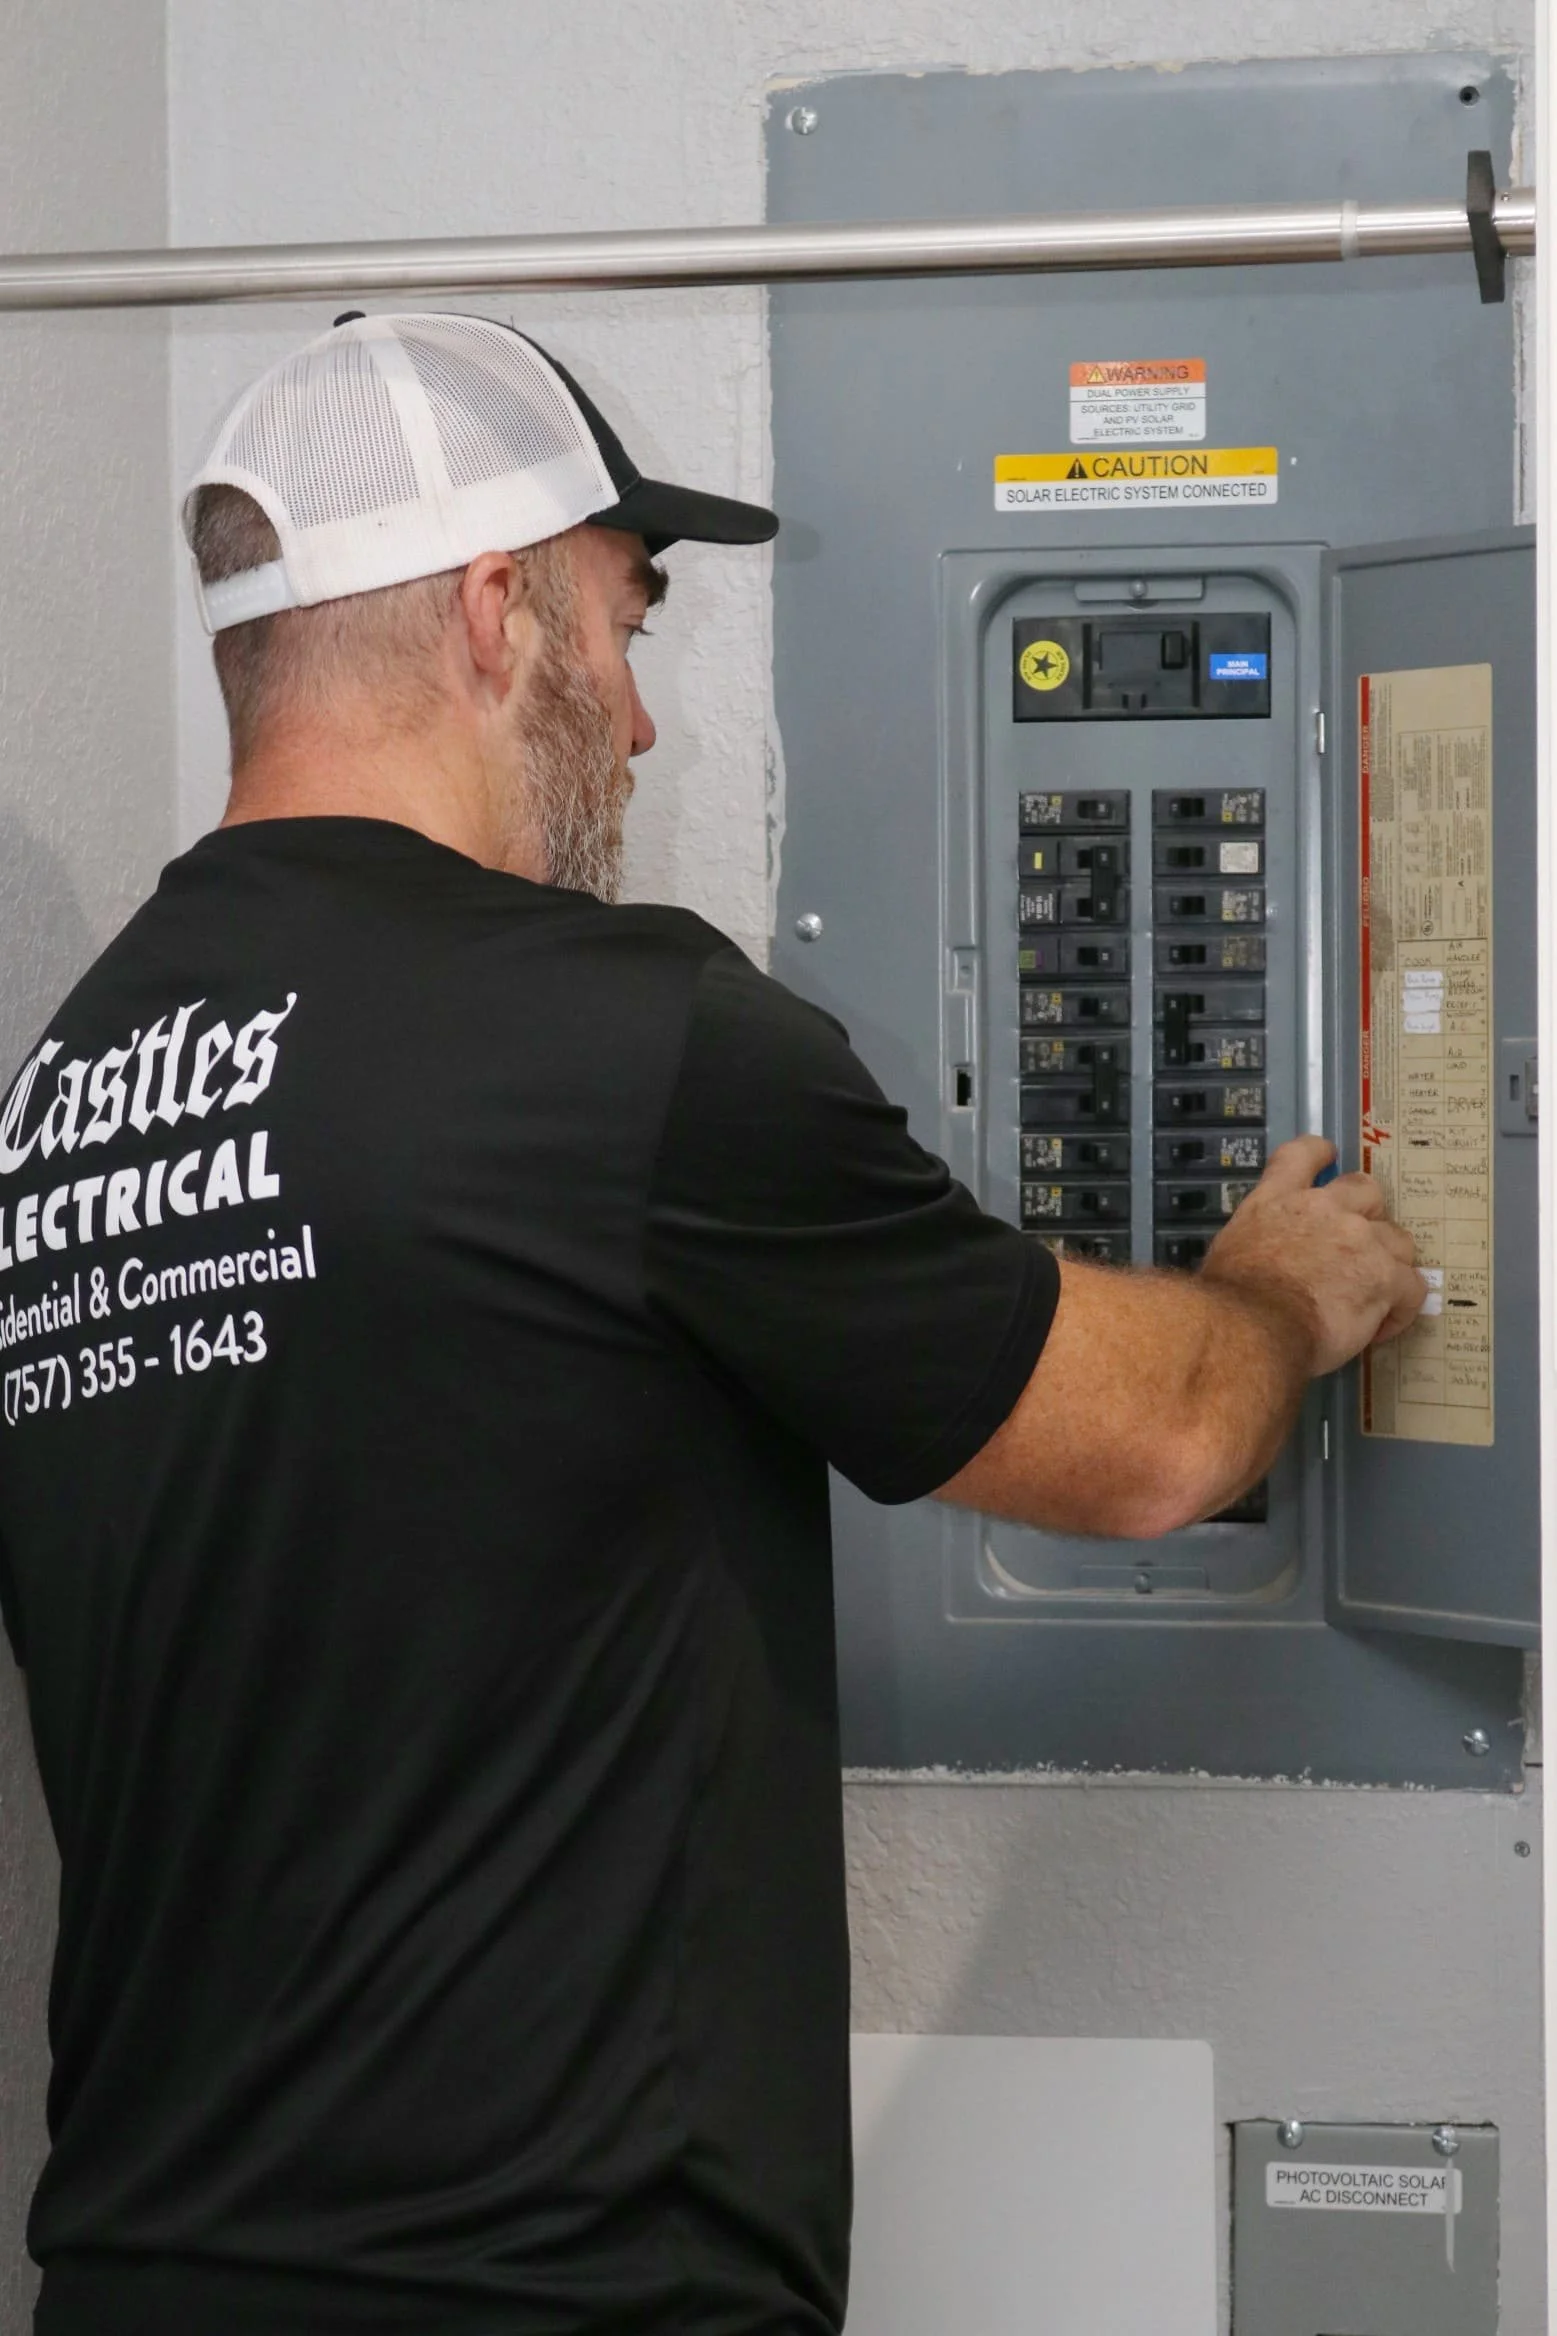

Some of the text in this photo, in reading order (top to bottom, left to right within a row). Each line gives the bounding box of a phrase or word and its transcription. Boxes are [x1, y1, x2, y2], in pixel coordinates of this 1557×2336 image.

[1106, 365, 1189, 381] WARNING
[1087, 386, 1190, 398] DUAL POWER SUPPLY
[1134, 403, 1169, 412] UTILITY
[1172, 402, 1196, 411] GRID
[1103, 414, 1174, 425] AND PV SOLAR
[1093, 426, 1184, 437] ELECTRIC SYSTEM
[1092, 454, 1208, 478] CAUTION
[1007, 482, 1267, 503] SOLAR ELECTRIC SYSTEM CONNECTED
[1216, 668, 1260, 676] PRINCIPAL
[1362, 725, 1370, 774] DANGER
[0, 992, 297, 1174] Castles
[0, 1225, 316, 1352] idential & Commercial
[5, 1355, 71, 1425] (757)
[80, 1337, 136, 1397] 355
[170, 1311, 267, 1374] 1643
[1276, 2169, 1394, 2188] PHOTOVOLTAIC
[1300, 2189, 1428, 2207] AC DISCONNECT
